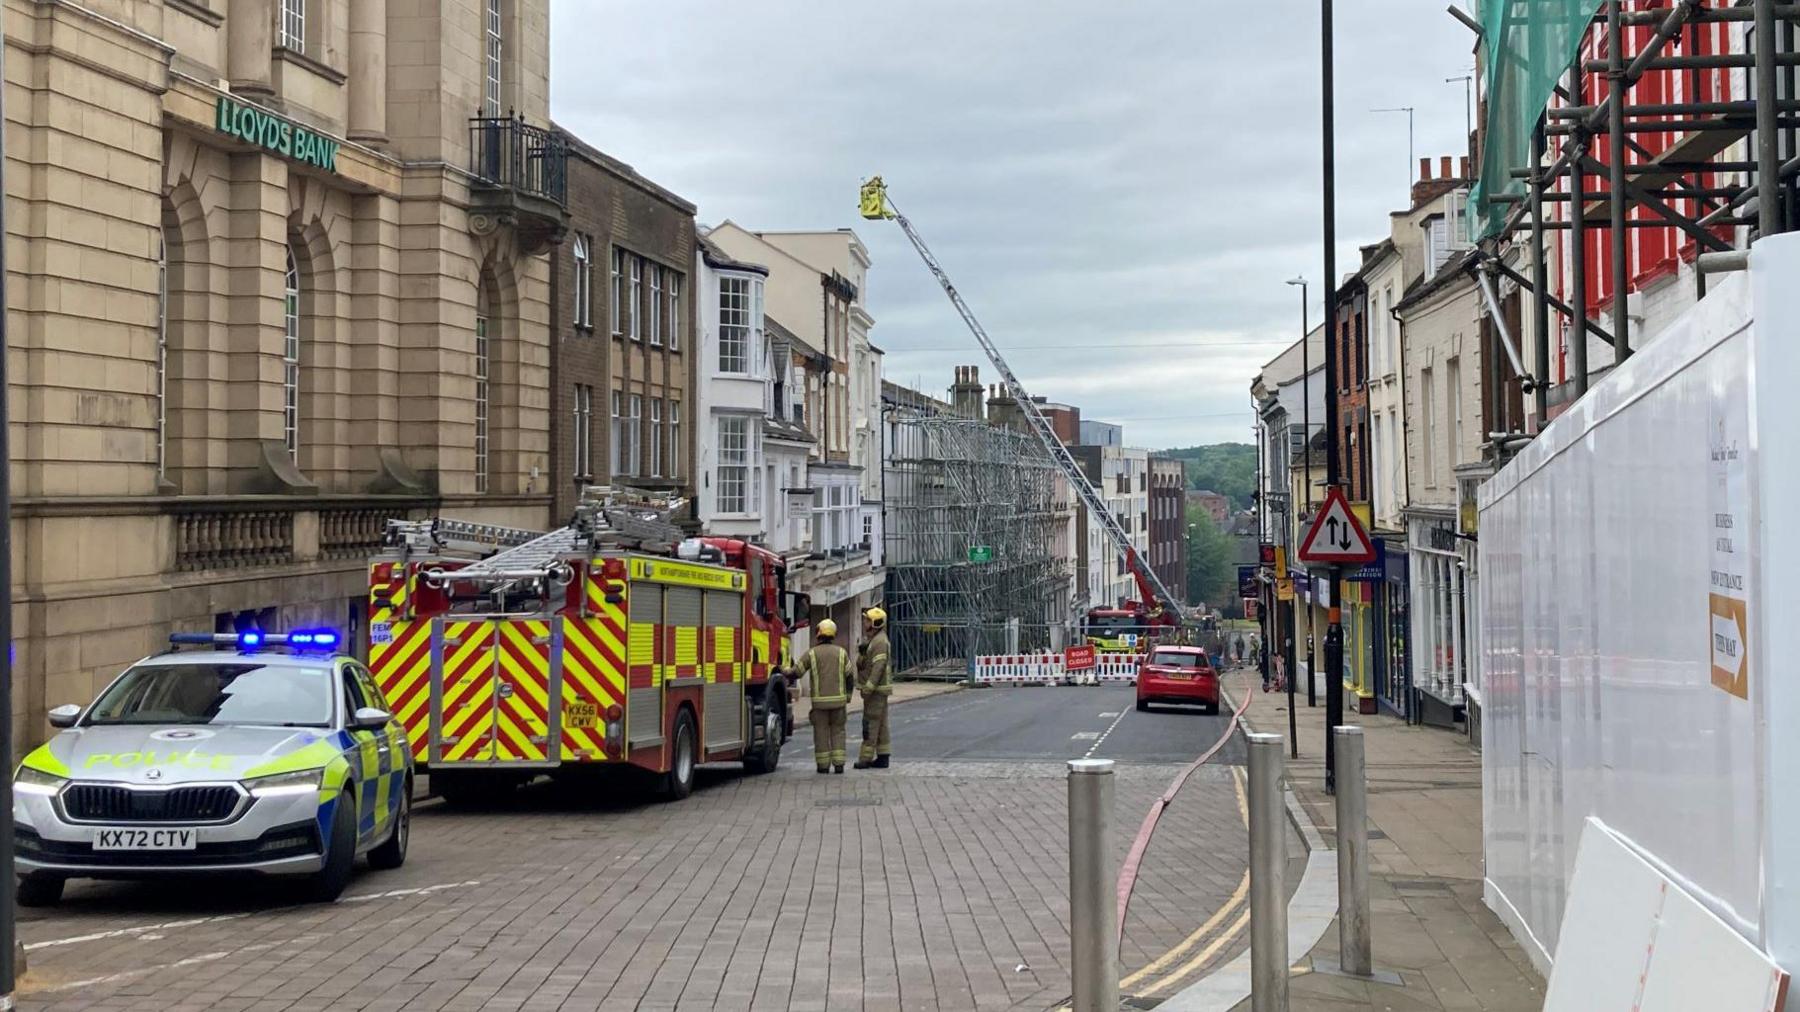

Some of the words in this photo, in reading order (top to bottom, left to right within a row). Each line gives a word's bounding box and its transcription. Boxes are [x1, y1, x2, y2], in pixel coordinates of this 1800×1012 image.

[218, 98, 290, 156] LLOYDS
[294, 128, 340, 175] BANK
[1725, 636, 1736, 657] WAY
[1068, 657, 1092, 665] CLOSED
[568, 704, 595, 716] KX56
[83, 752, 236, 769] POLICE
[100, 830, 148, 846] KX72
[153, 830, 190, 846] CTV
